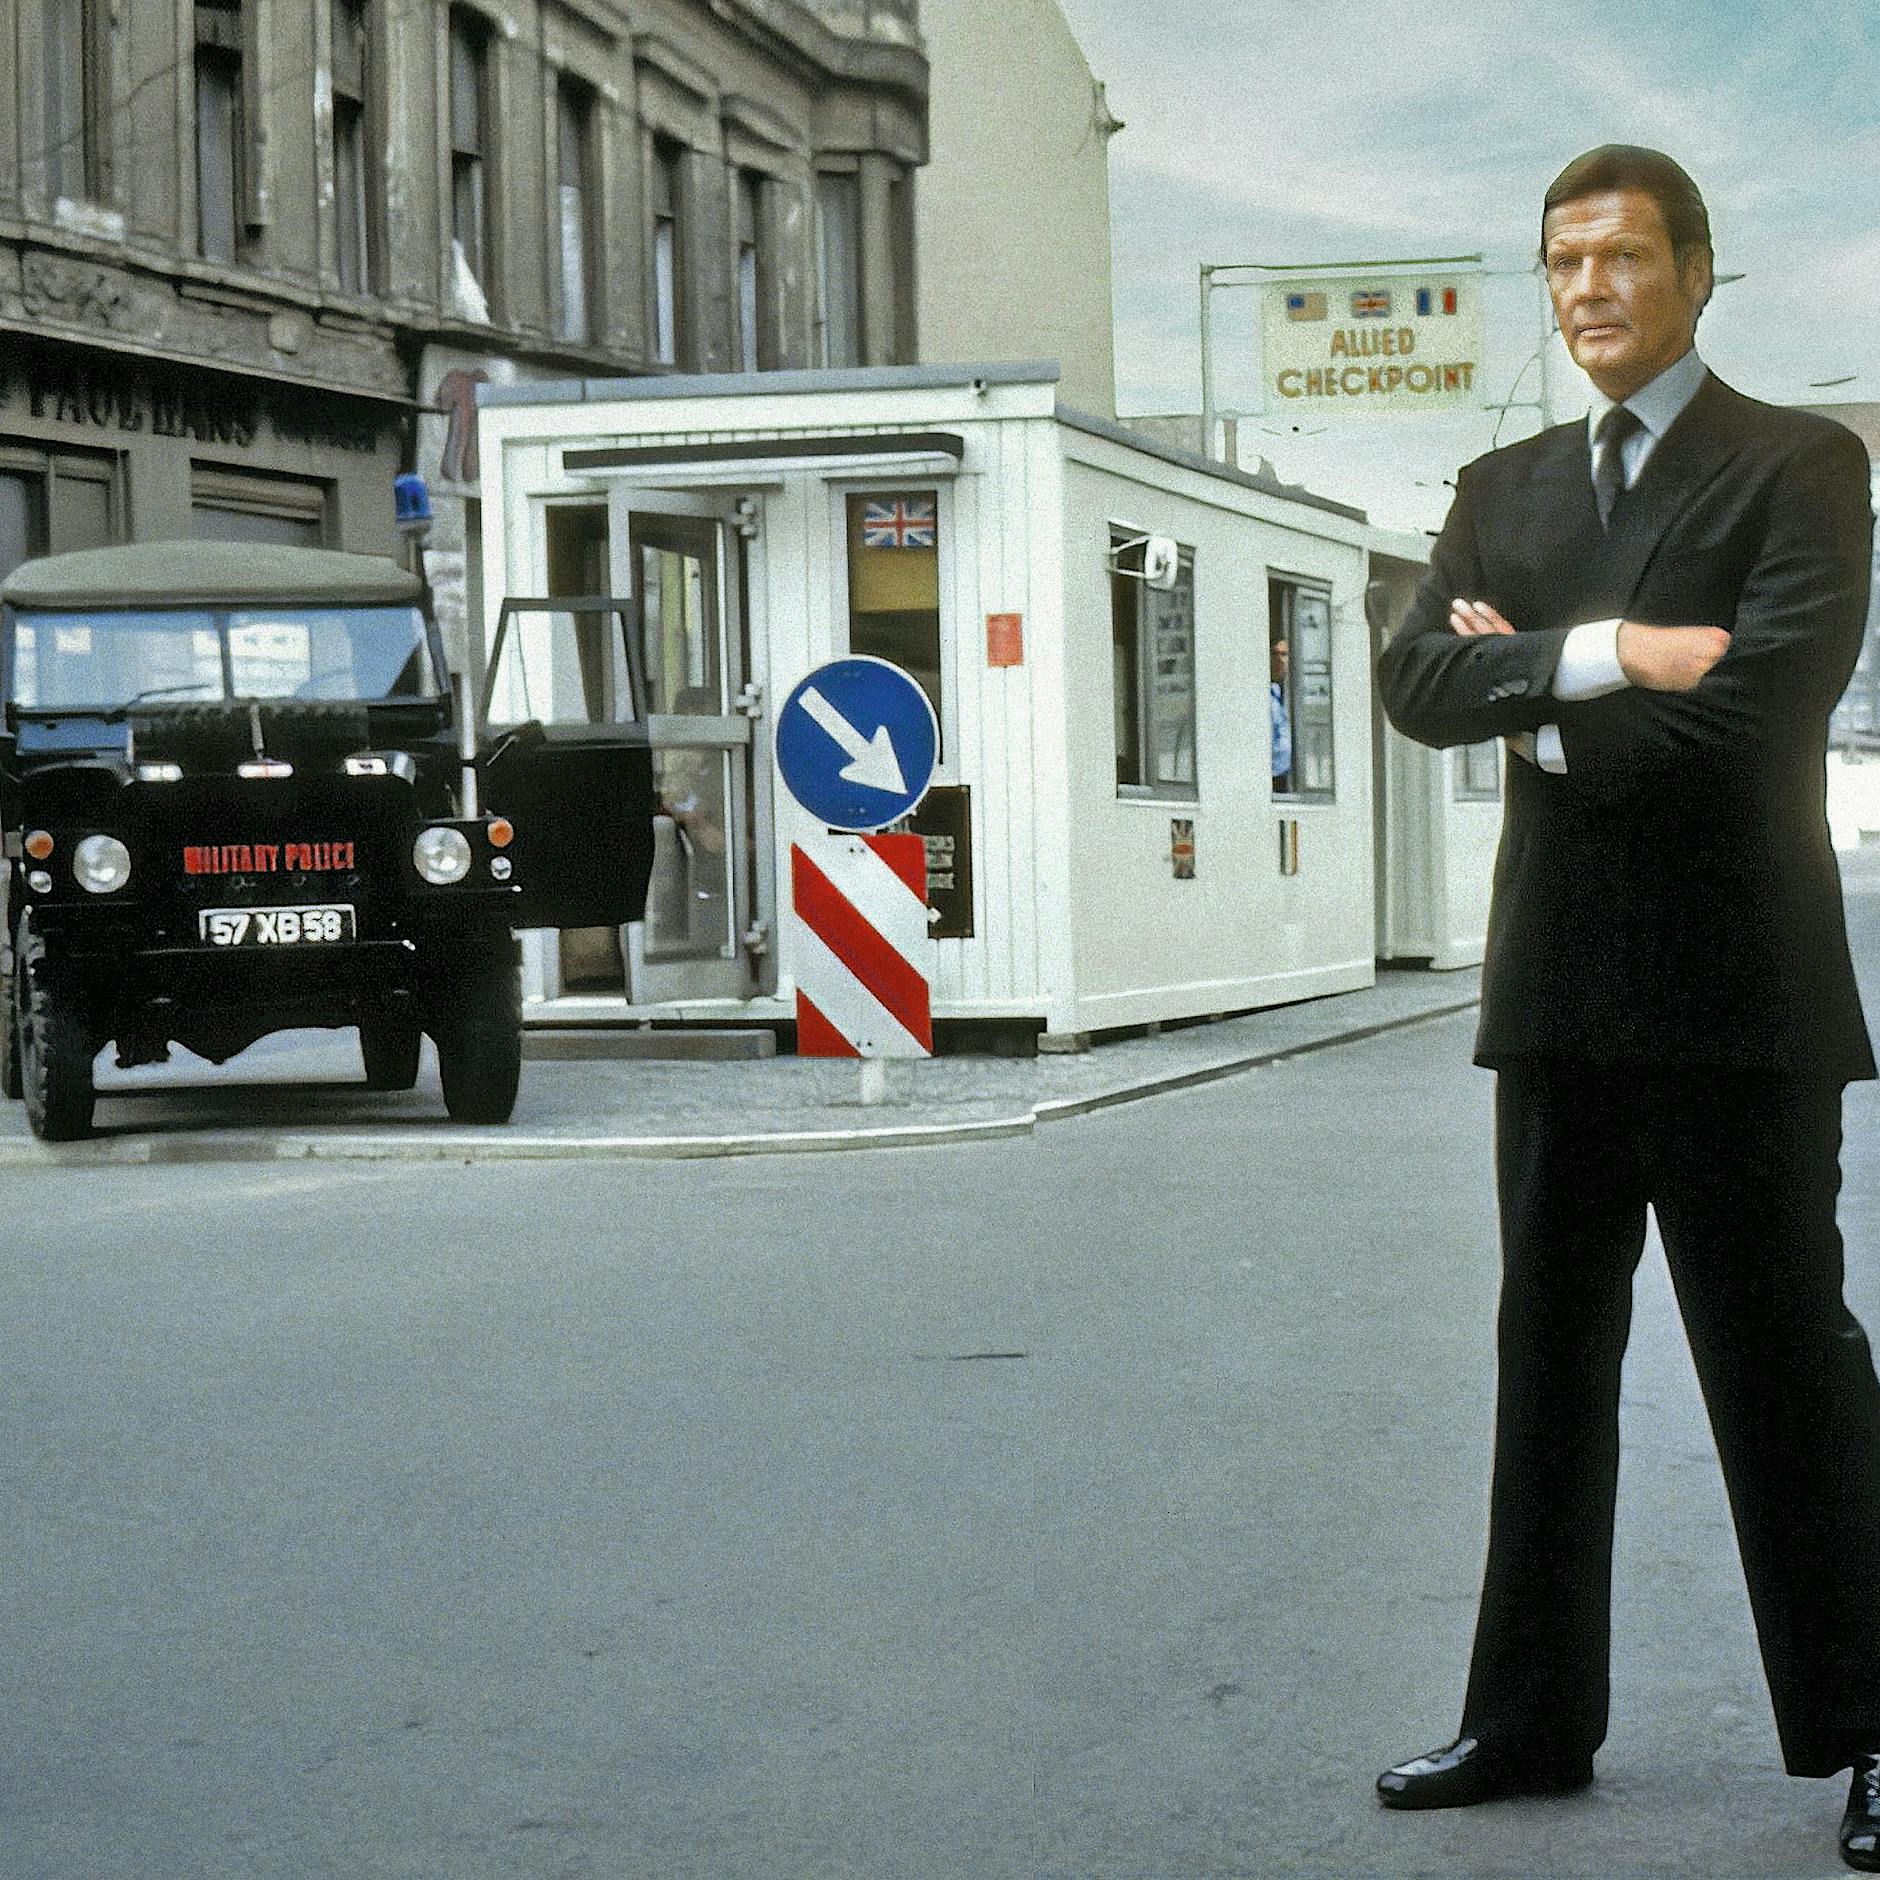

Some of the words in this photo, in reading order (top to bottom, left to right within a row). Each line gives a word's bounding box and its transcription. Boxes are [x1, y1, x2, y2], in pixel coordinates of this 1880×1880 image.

[1331, 327, 1415, 358] ALLIED
[1277, 362, 1475, 399] CHECKPOINT
[184, 844, 279, 874] MILITARY
[210, 914, 250, 945] 57
[255, 912, 300, 944] XB
[303, 910, 341, 942] 58
